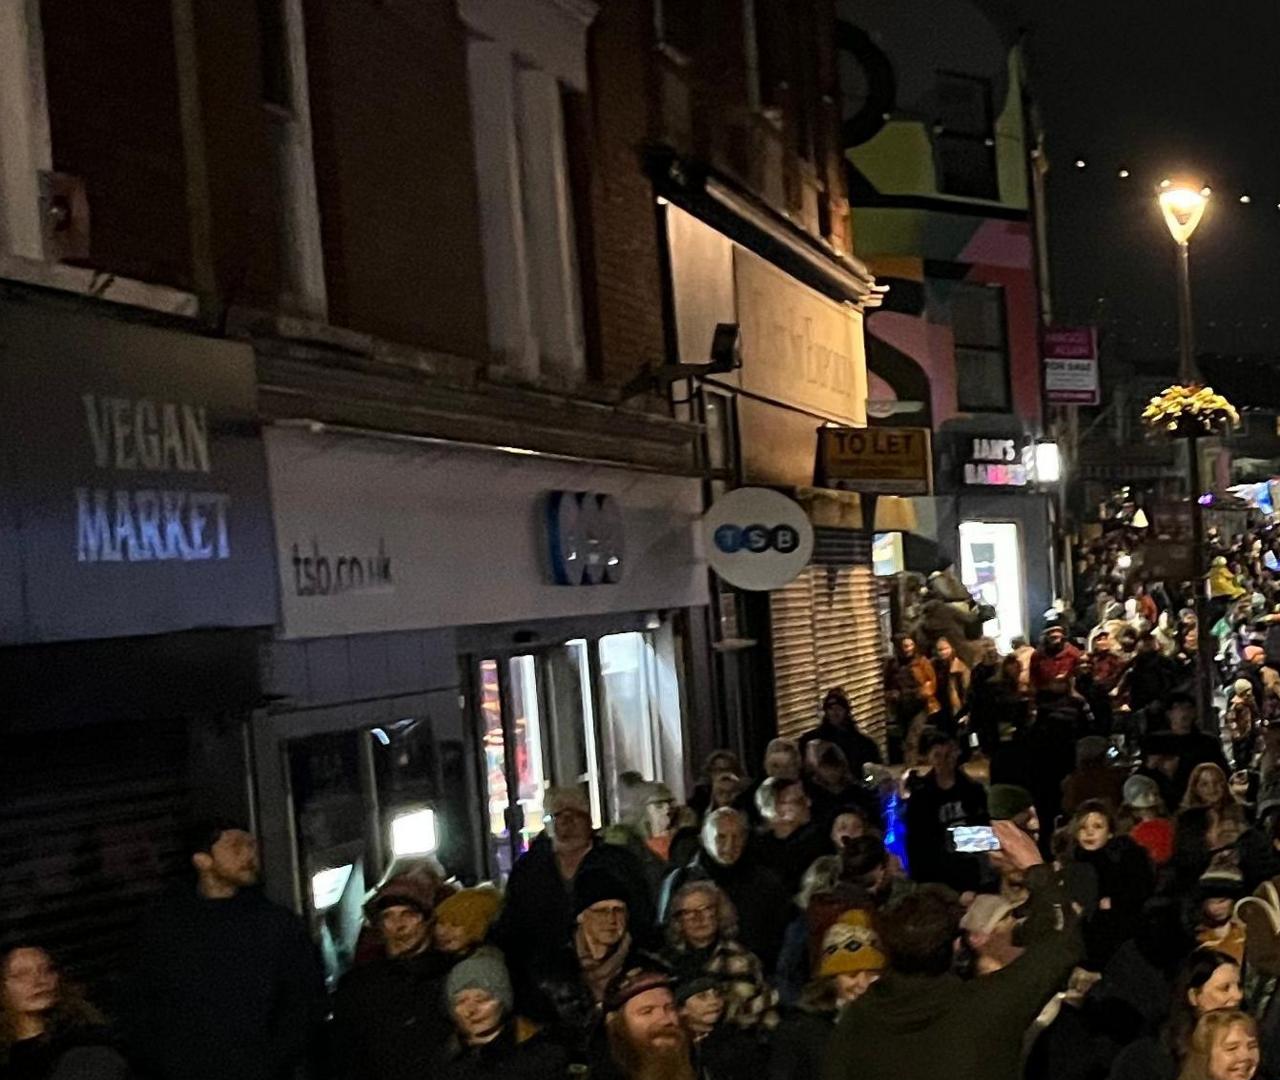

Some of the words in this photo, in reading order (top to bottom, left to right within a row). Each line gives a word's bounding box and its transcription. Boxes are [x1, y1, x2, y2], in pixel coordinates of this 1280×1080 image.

[80, 395, 211, 472] VEGAN
[833, 432, 866, 455] TO
[873, 433, 914, 455] LET
[75, 488, 231, 562] MARKET
[715, 525, 799, 552] TSB
